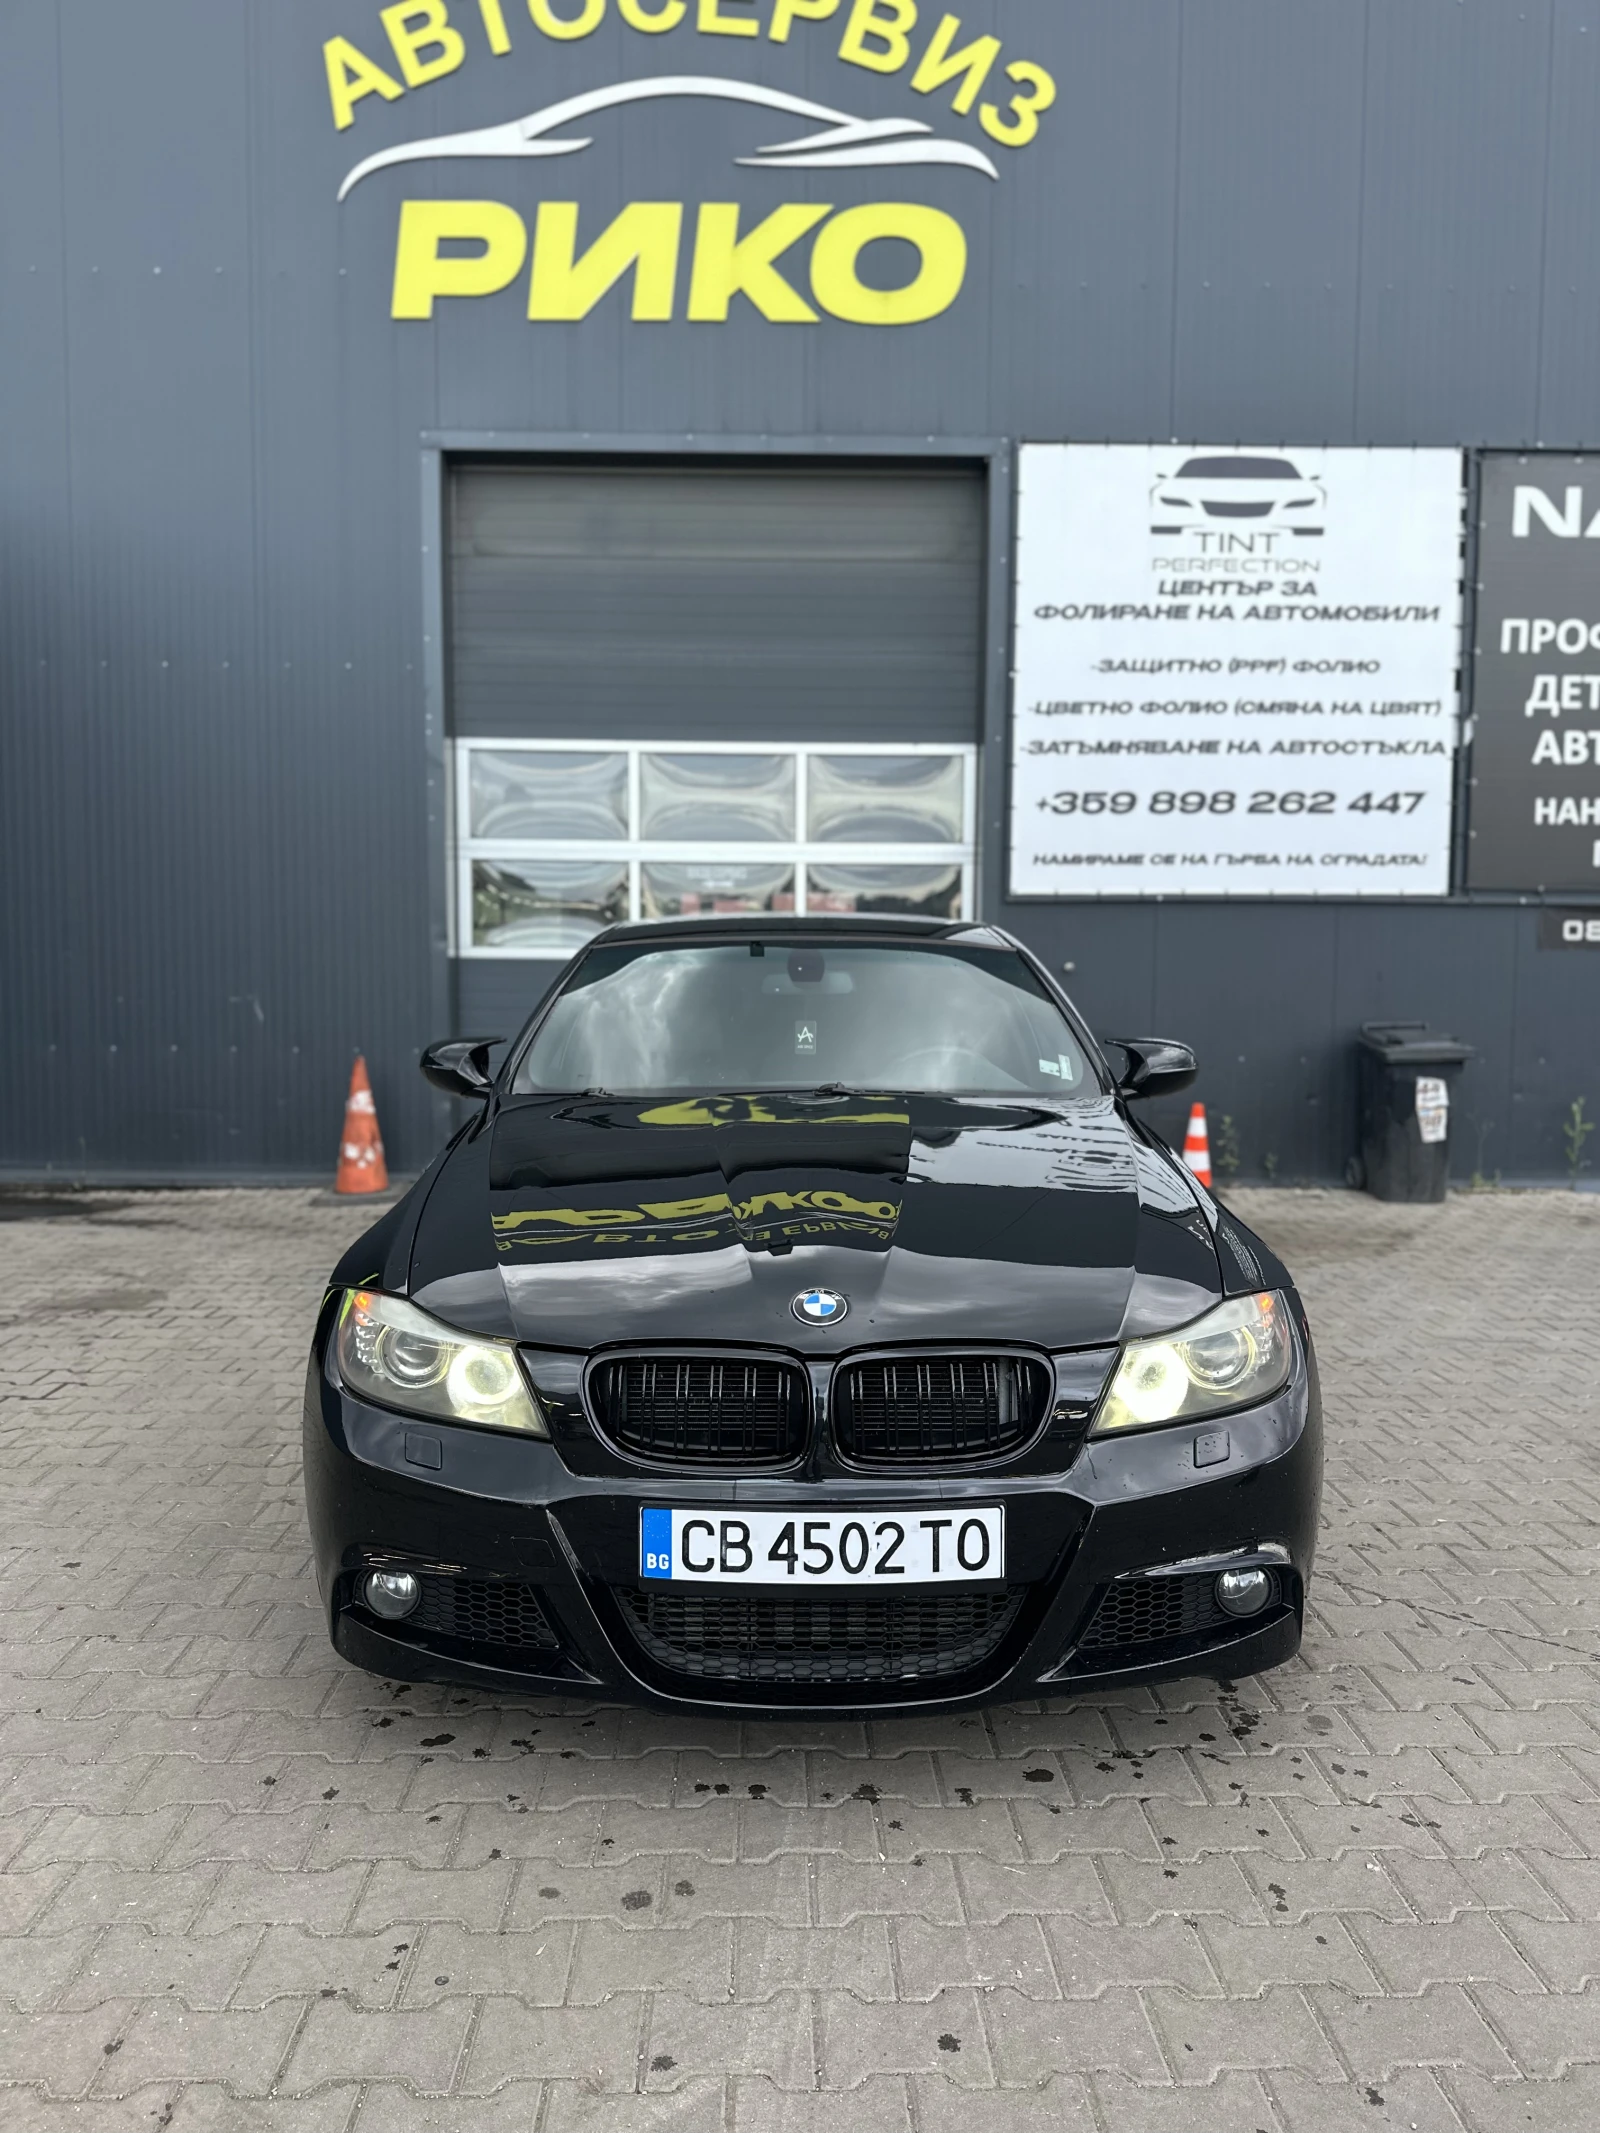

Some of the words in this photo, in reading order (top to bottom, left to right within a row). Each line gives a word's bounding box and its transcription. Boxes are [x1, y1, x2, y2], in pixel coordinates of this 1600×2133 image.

[391, 201, 967, 325] РИКО
[1512, 485, 1600, 538] N
[1193, 532, 1280, 554] TINT
[1151, 557, 1321, 574] PERFECTION
[1158, 579, 1274, 597] ЦЕНТЪР
[1280, 580, 1318, 597] ЗА
[1034, 603, 1190, 621] ФОЛИРАНЕ
[1197, 604, 1234, 621] НА
[1243, 605, 1440, 623] АВТОМОБИЛИ
[1292, 659, 1381, 674] ФОЛИО
[1140, 700, 1228, 715] ФОЛИО
[1234, 700, 1324, 716] (СМЯНА
[1330, 700, 1363, 715] НА
[1226, 740, 1262, 756] НА
[1269, 740, 1447, 757] АВТОСТЪКЛА
[1035, 791, 1138, 815] +359
[1147, 791, 1237, 815] 898
[1246, 791, 1336, 815] 262
[1347, 791, 1427, 815] 447
[1033, 853, 1145, 867] НАМИРАМЕ
[1149, 853, 1177, 867] СЕ
[1181, 853, 1208, 867] НА
[1286, 853, 1314, 867] НА
[681, 1519, 753, 1574] CB
[767, 1521, 905, 1575] 4502
[646, 1553, 669, 1570] BG
